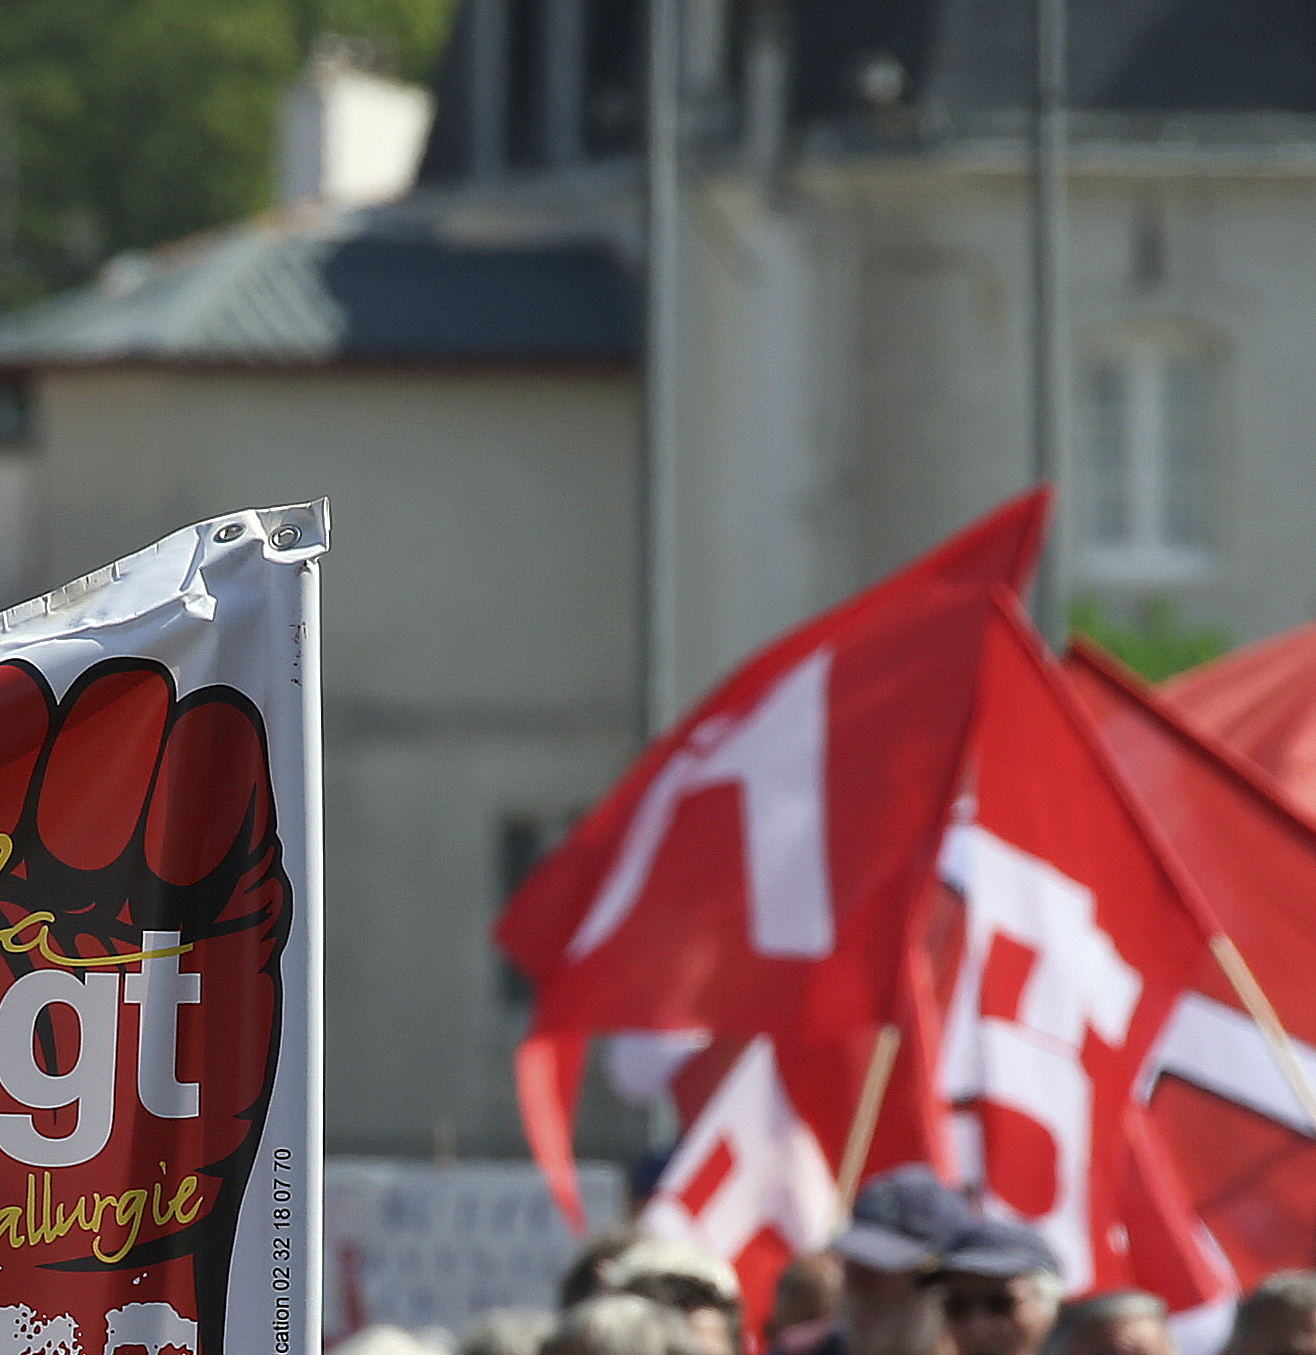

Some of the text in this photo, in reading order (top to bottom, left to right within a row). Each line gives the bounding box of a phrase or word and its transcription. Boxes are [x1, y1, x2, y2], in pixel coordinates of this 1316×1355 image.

[273, 1147, 293, 1171] 70
[273, 1178, 292, 1202] 07
[273, 1208, 292, 1230] 18
[272, 1237, 291, 1261] 32
[272, 1267, 291, 1292] 02
